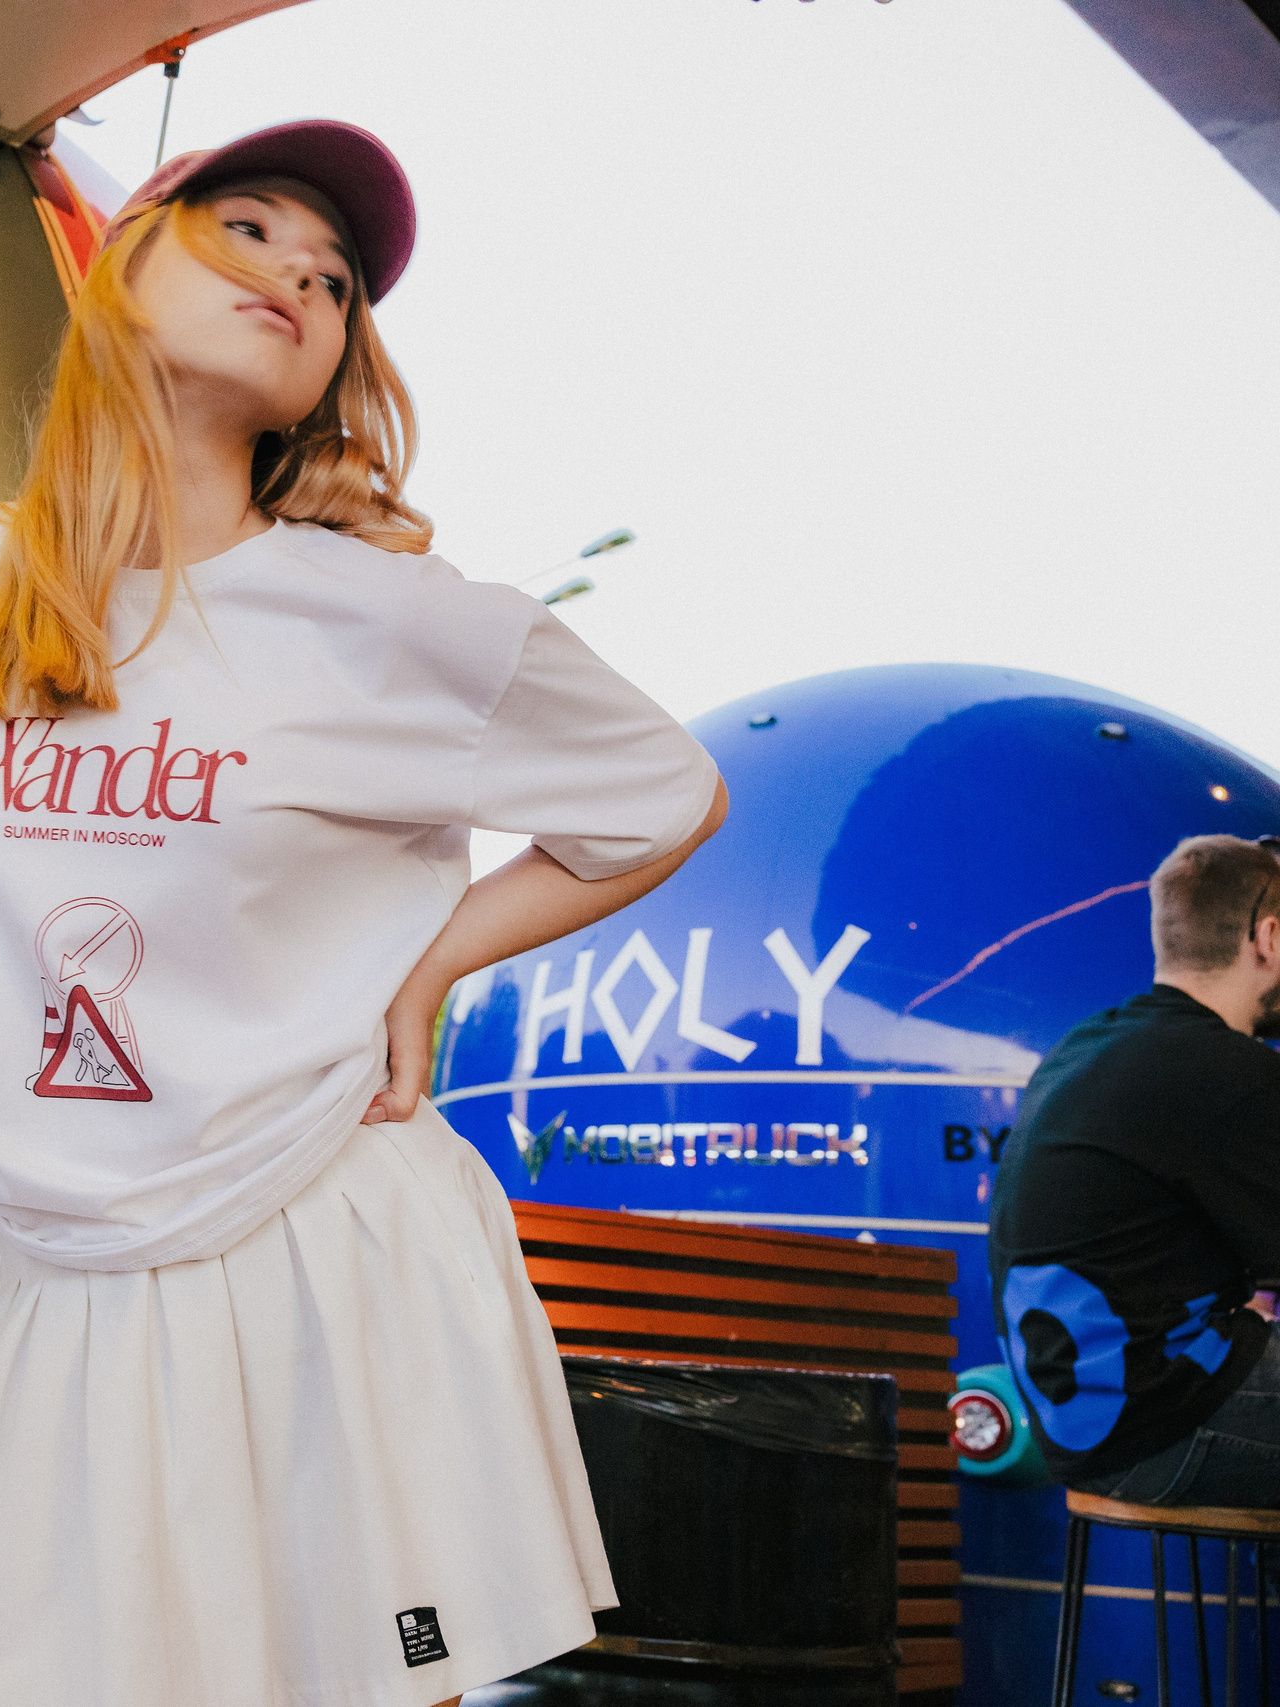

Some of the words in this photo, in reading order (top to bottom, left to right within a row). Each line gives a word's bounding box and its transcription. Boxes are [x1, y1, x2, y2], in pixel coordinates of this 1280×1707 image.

[3, 825, 70, 842] SUMMER
[73, 828, 89, 843] IN
[92, 830, 166, 848] MOSCOW
[522, 923, 872, 1073] HOLY
[563, 1121, 868, 1167] MOBITRUCK
[943, 1124, 1012, 1164] BY
